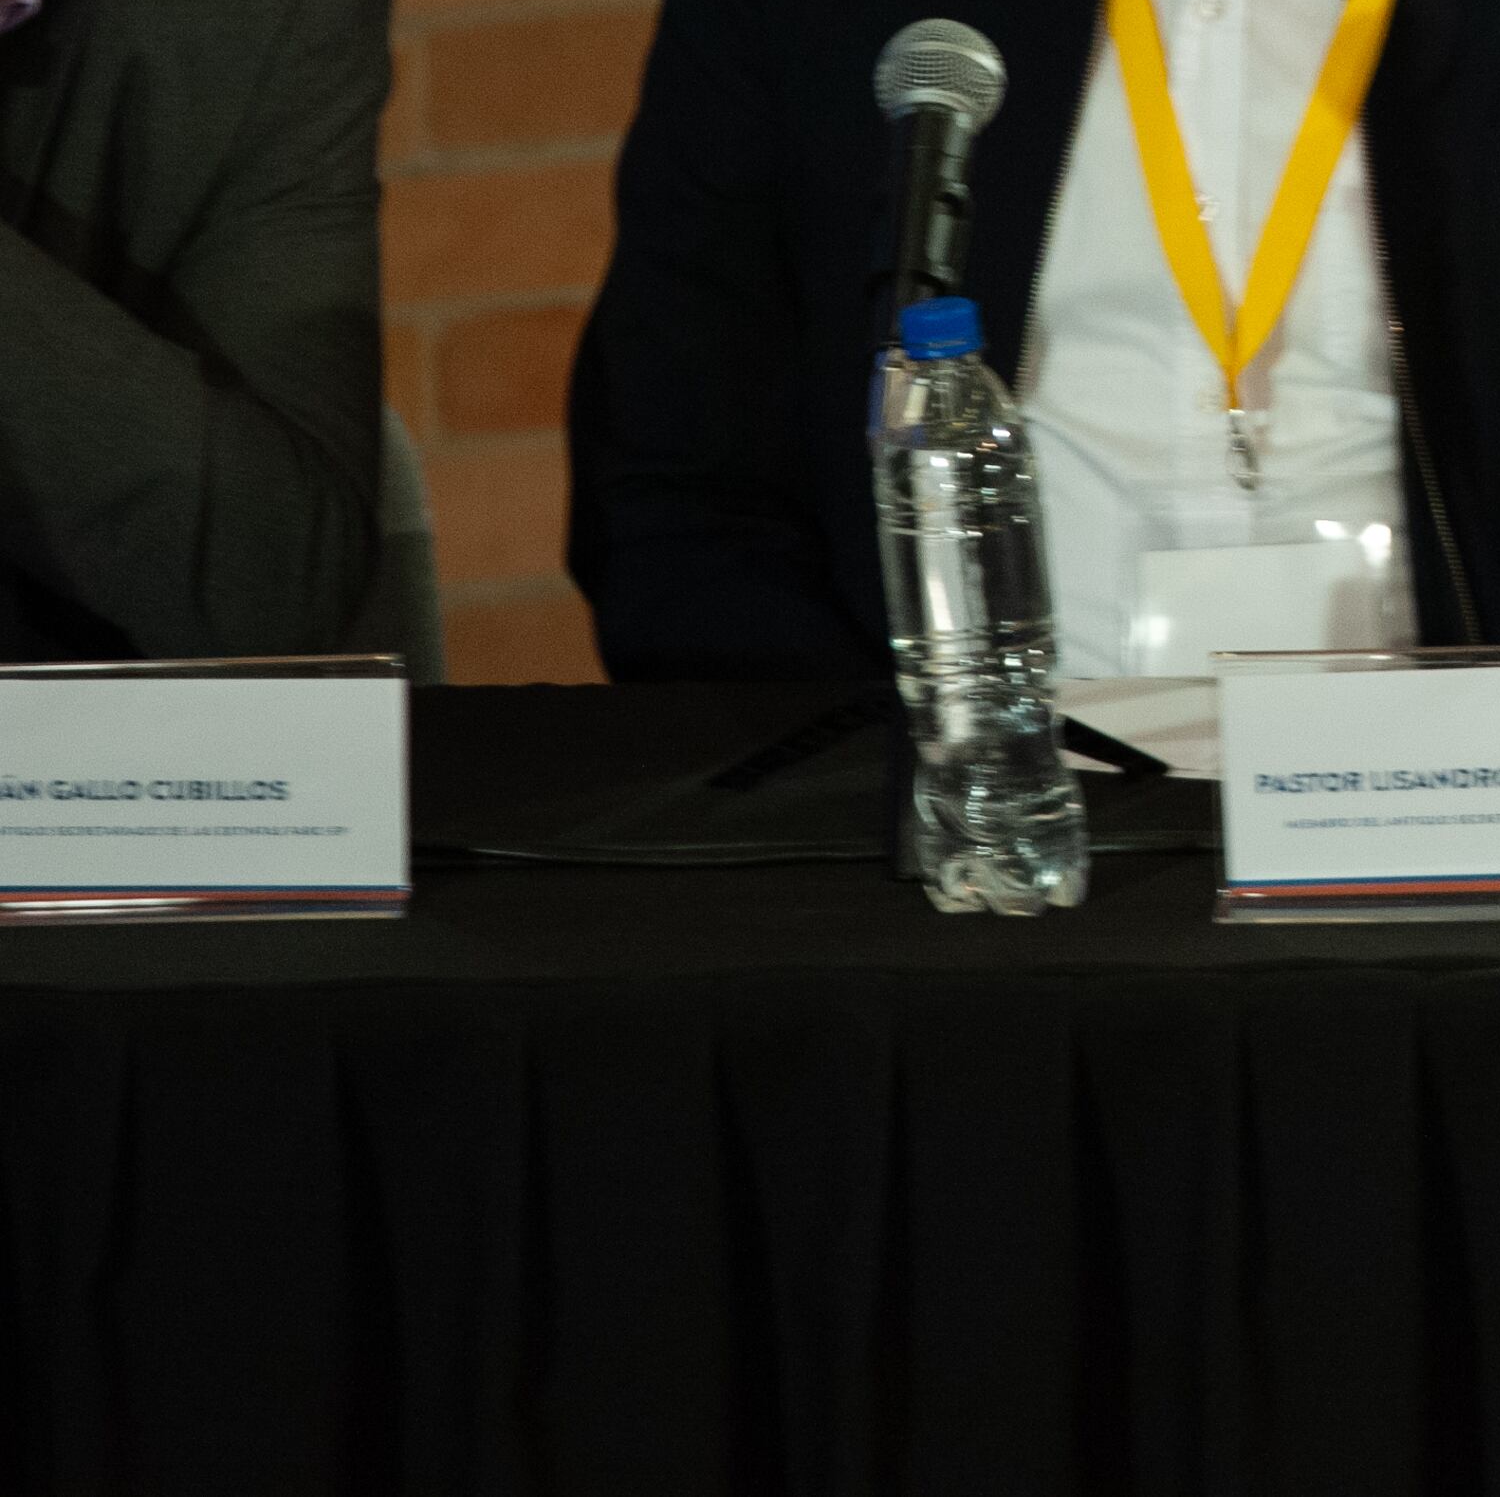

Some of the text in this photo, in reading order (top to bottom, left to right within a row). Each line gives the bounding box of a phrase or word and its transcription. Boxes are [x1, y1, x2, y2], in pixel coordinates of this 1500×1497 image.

[47, 779, 143, 801] GALLO
[146, 779, 291, 801] CUBILLOS
[1254, 770, 1366, 794] PASTOR
